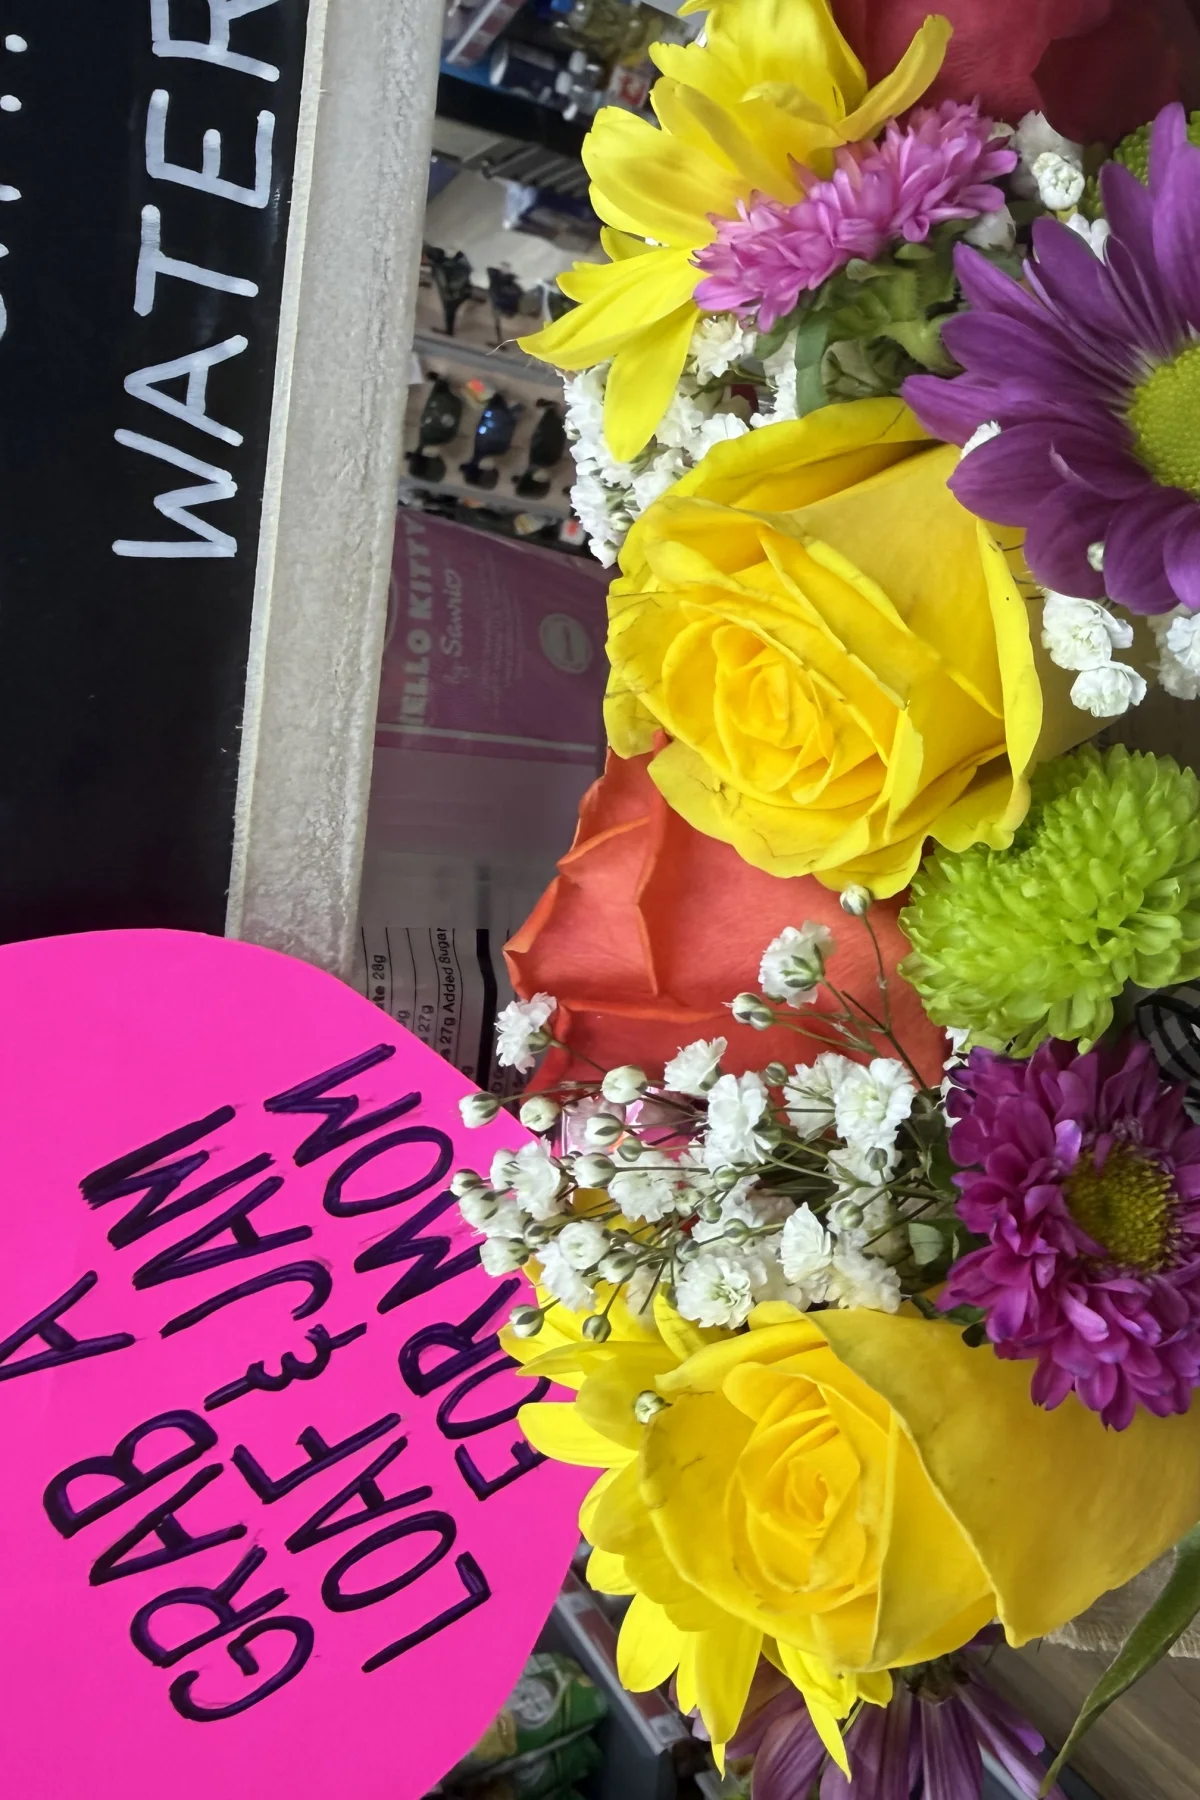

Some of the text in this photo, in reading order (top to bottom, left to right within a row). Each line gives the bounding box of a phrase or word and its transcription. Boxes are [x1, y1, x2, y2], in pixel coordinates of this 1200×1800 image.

[112, 0, 280, 558] WATER
[403, 515, 432, 620] KITTY
[371, 954, 388, 981] 28g
[418, 1004, 435, 1033] 27g
[439, 1017, 457, 1045] 27g
[442, 966, 456, 1014] Added
[78, 1104, 333, 1340] JAM
[263, 1042, 552, 1501] FOR MOM
[0, 1270, 315, 1723] GRAB A
[231, 1412, 492, 1673] LOAF
